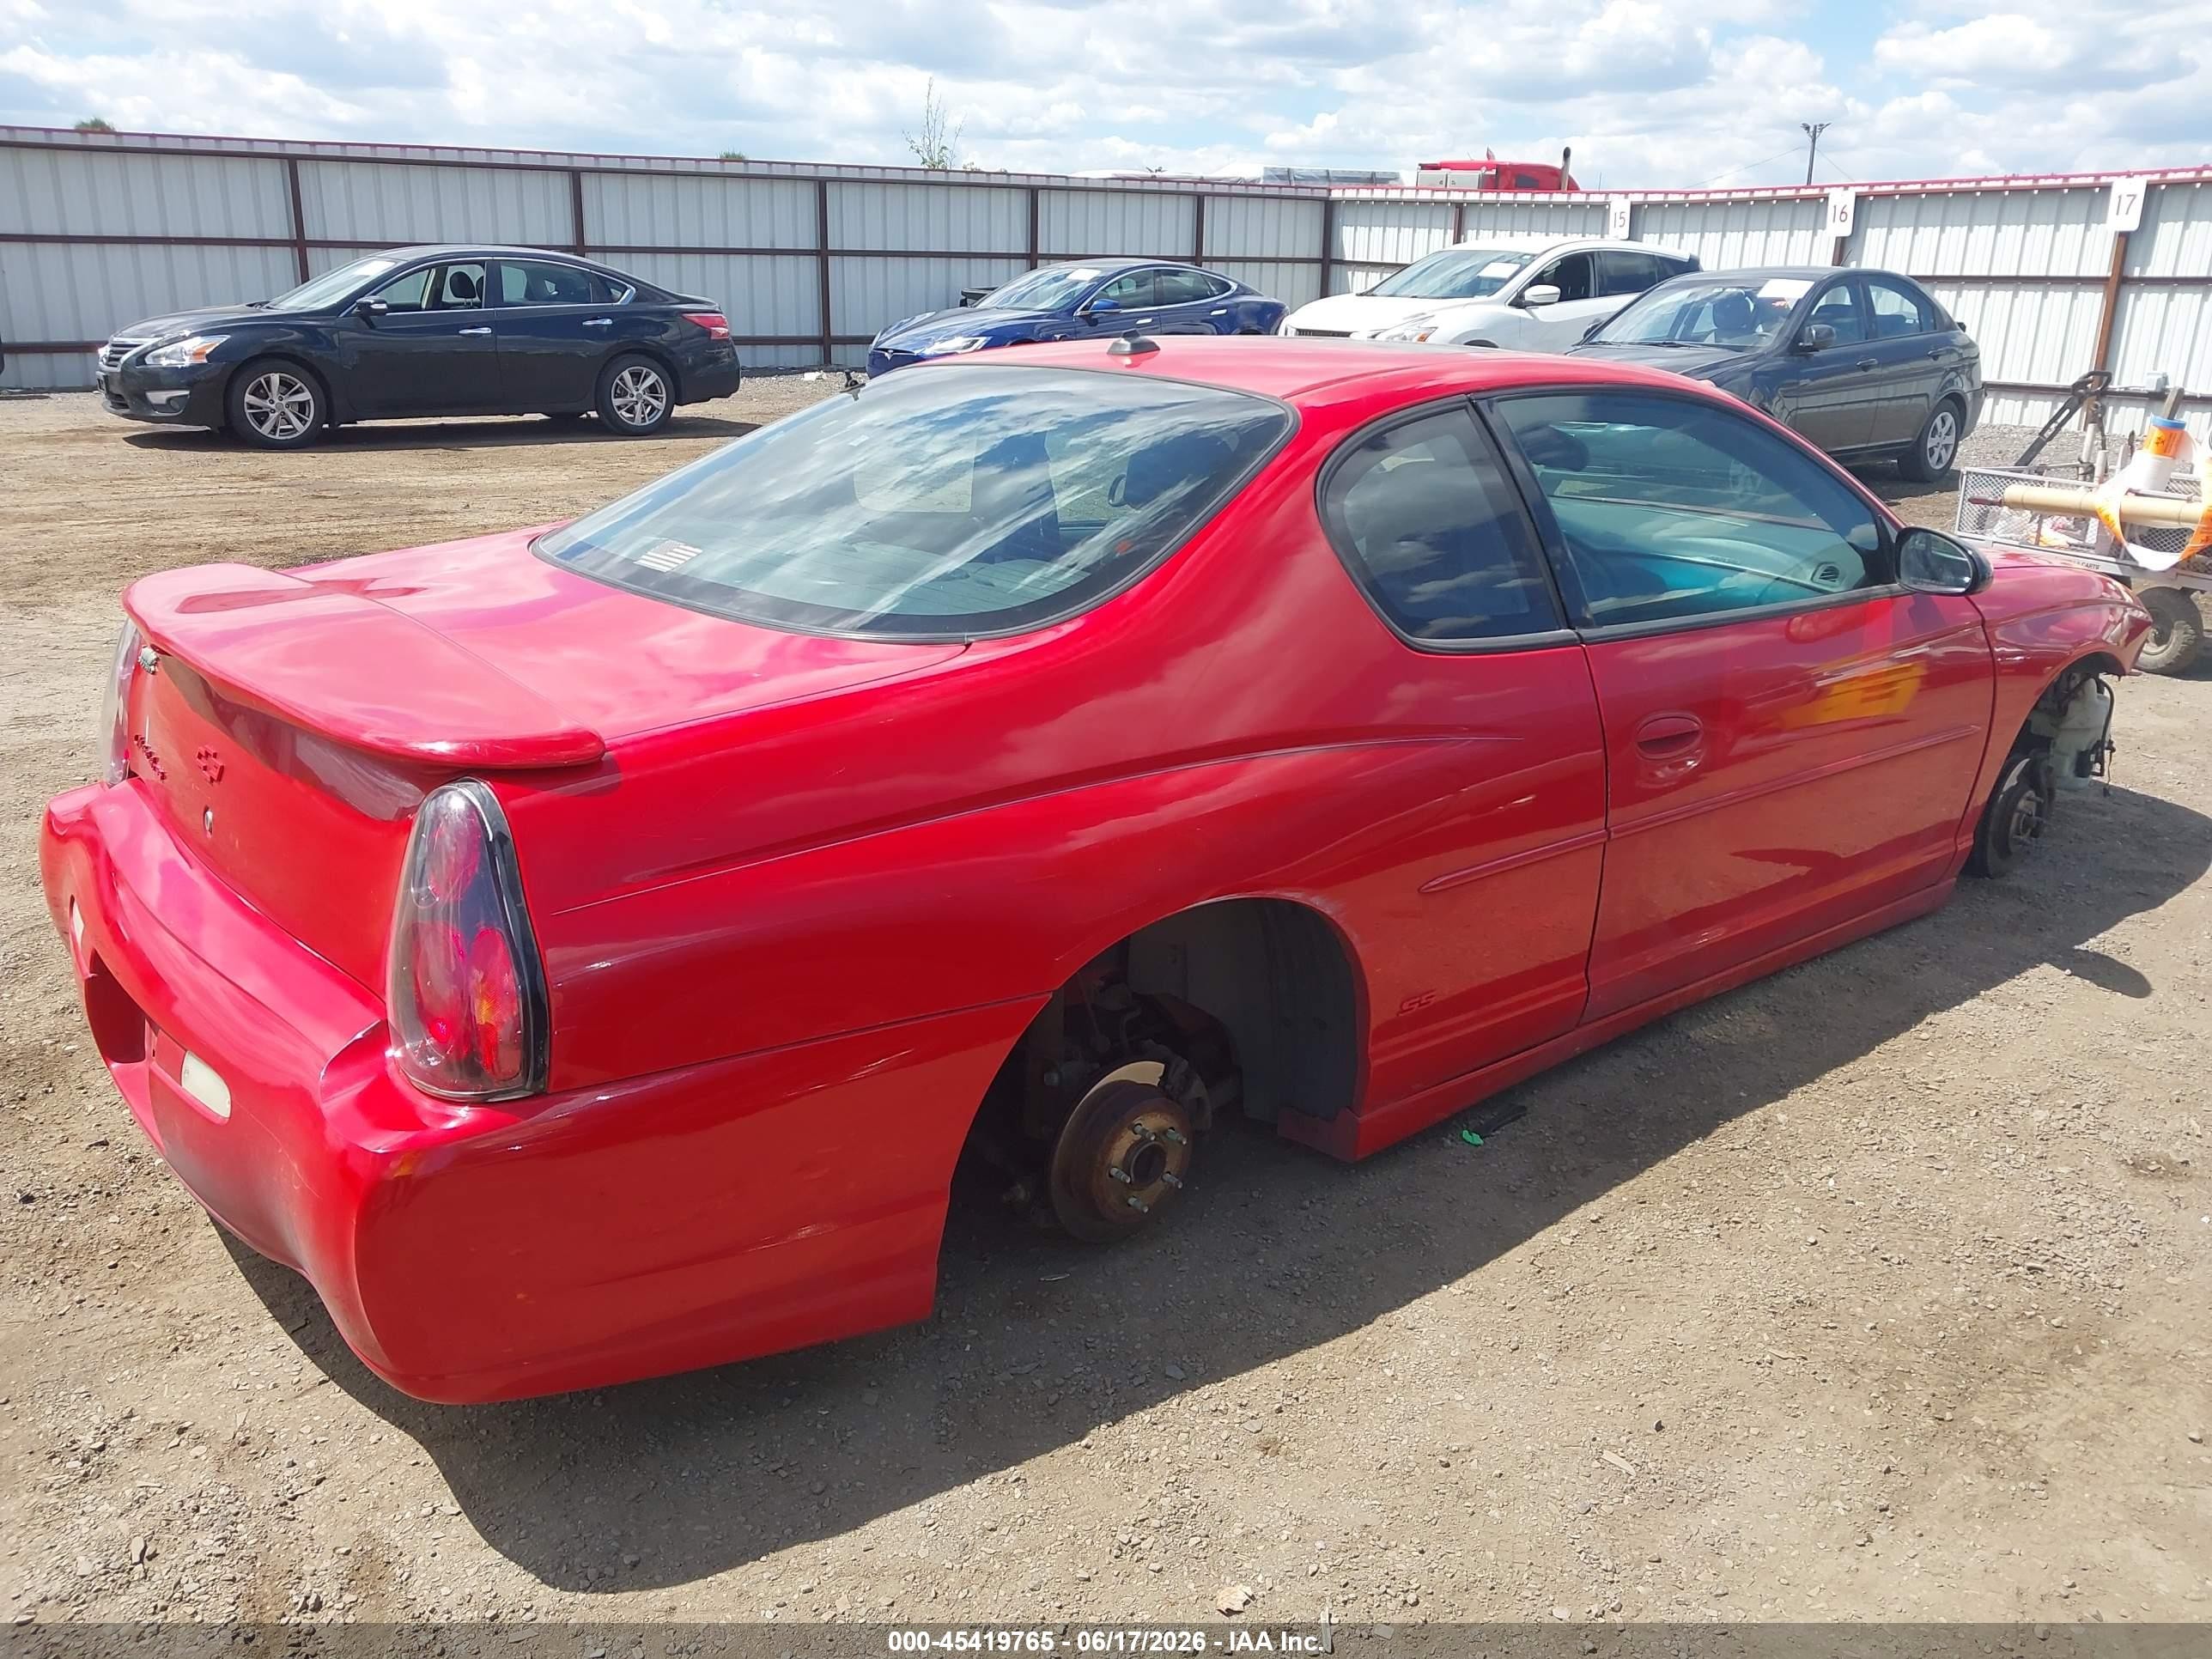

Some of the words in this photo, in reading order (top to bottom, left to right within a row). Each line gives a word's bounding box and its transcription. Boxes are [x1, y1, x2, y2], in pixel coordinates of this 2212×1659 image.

[1832, 204, 1848, 223] 16
[2116, 193, 2137, 216] 17
[1613, 211, 1626, 228] 15
[1396, 988, 1437, 1017] SS
